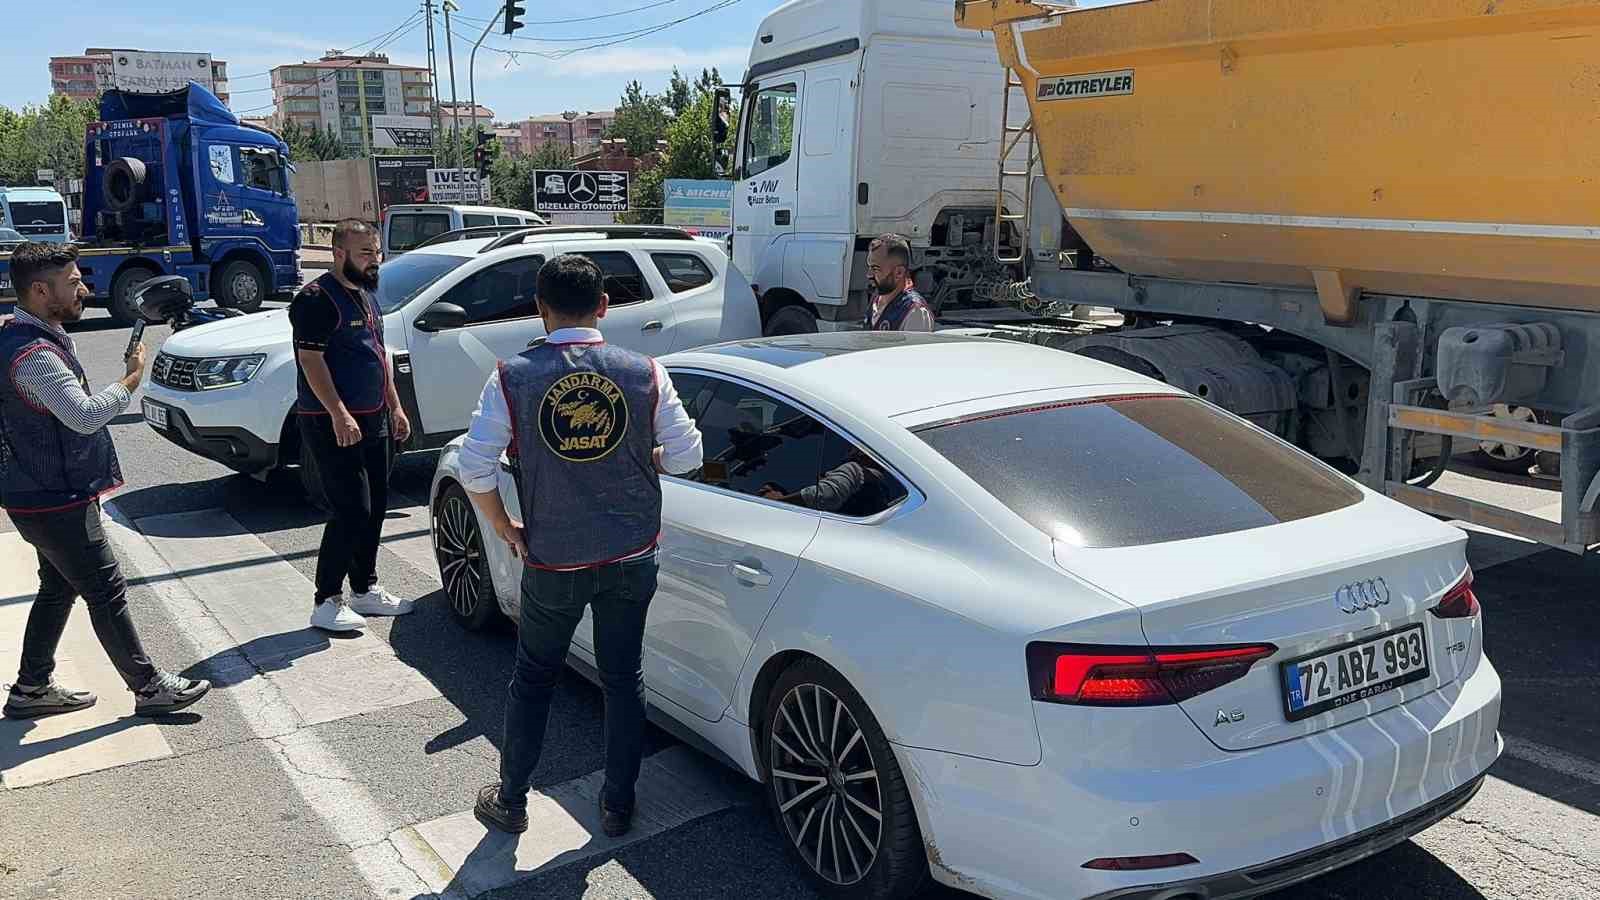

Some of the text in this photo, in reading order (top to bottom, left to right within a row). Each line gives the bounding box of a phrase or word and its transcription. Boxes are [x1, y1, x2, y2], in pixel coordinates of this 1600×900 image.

[135, 58, 192, 70] BATMAN
[1056, 76, 1132, 96] ÖZTREYLER
[538, 202, 627, 210] DİZELLER OTOMOTİV
[547, 374, 620, 406] JANDARMA
[560, 434, 609, 451] JASAT
[1289, 632, 1423, 702] TR 72 ABZ 993
[1334, 694, 1356, 707] ONE
